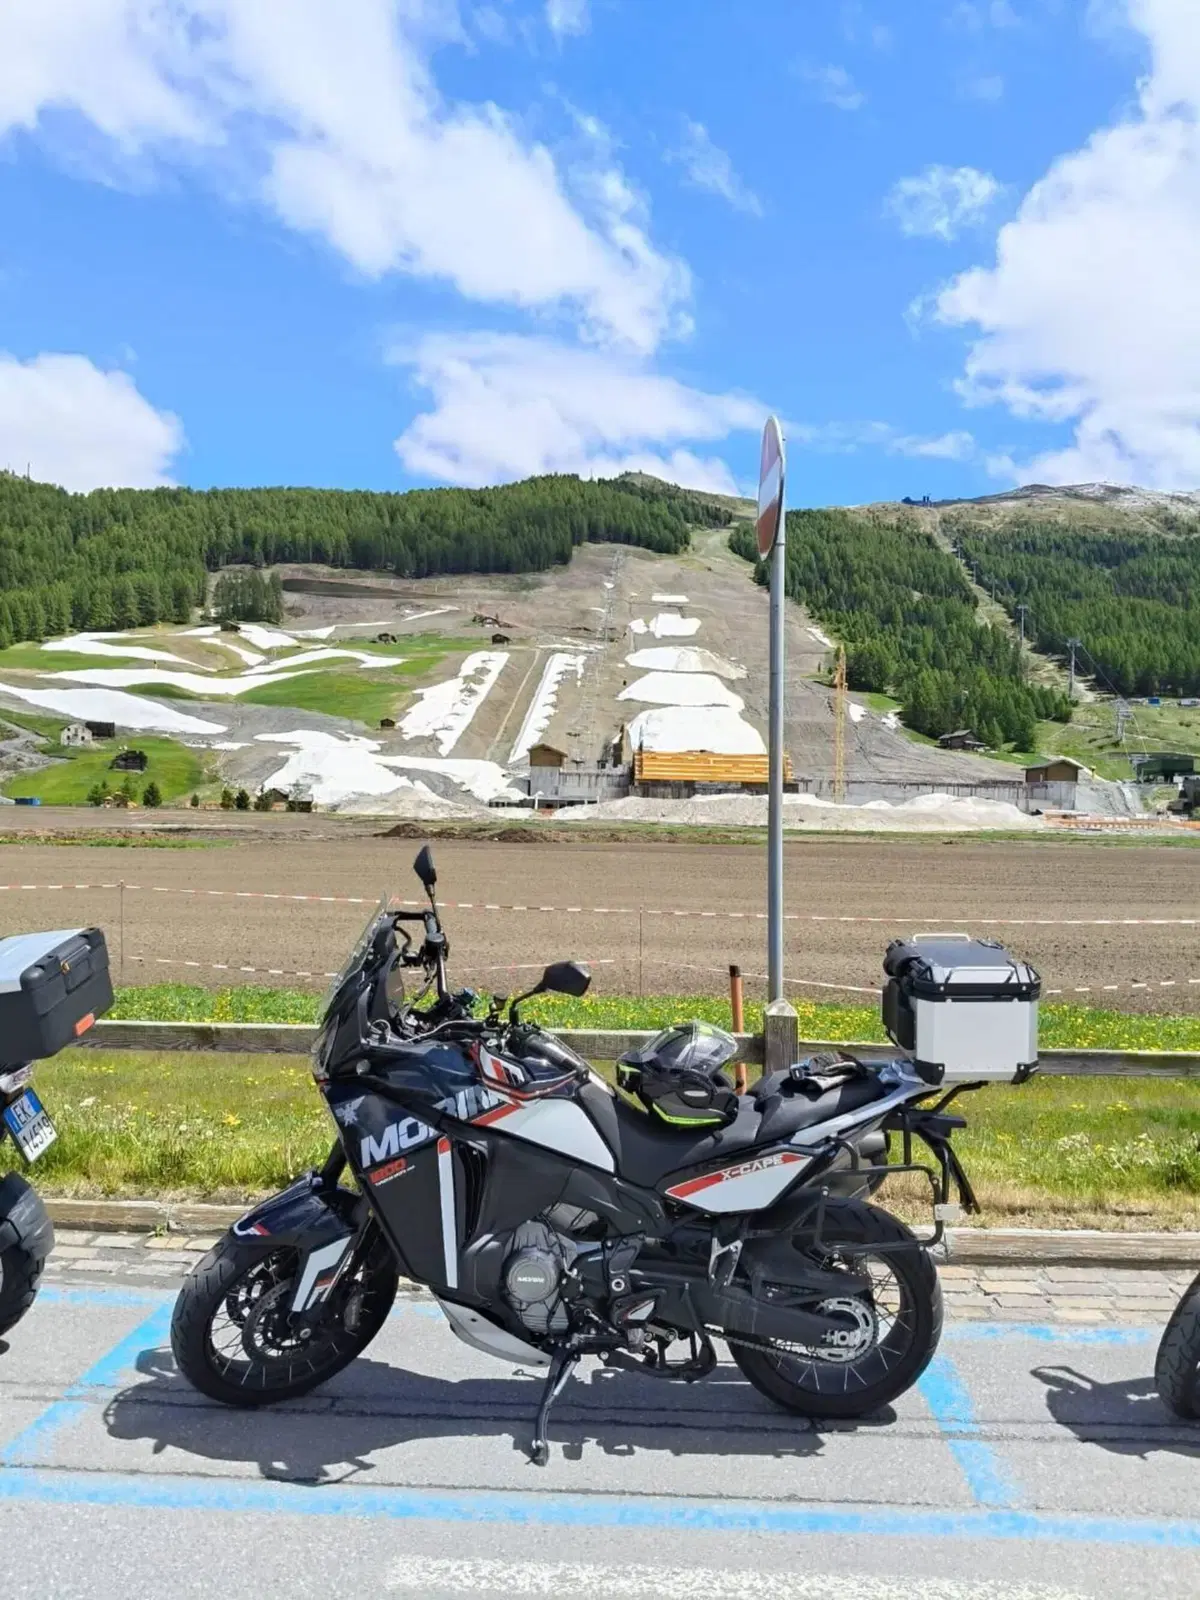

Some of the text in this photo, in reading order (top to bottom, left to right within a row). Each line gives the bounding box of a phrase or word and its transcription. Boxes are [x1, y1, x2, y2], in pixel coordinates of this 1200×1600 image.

[13, 1101, 31, 1125] EK
[22, 1116, 53, 1153] 14519
[721, 1155, 783, 1181] X-CAPE
